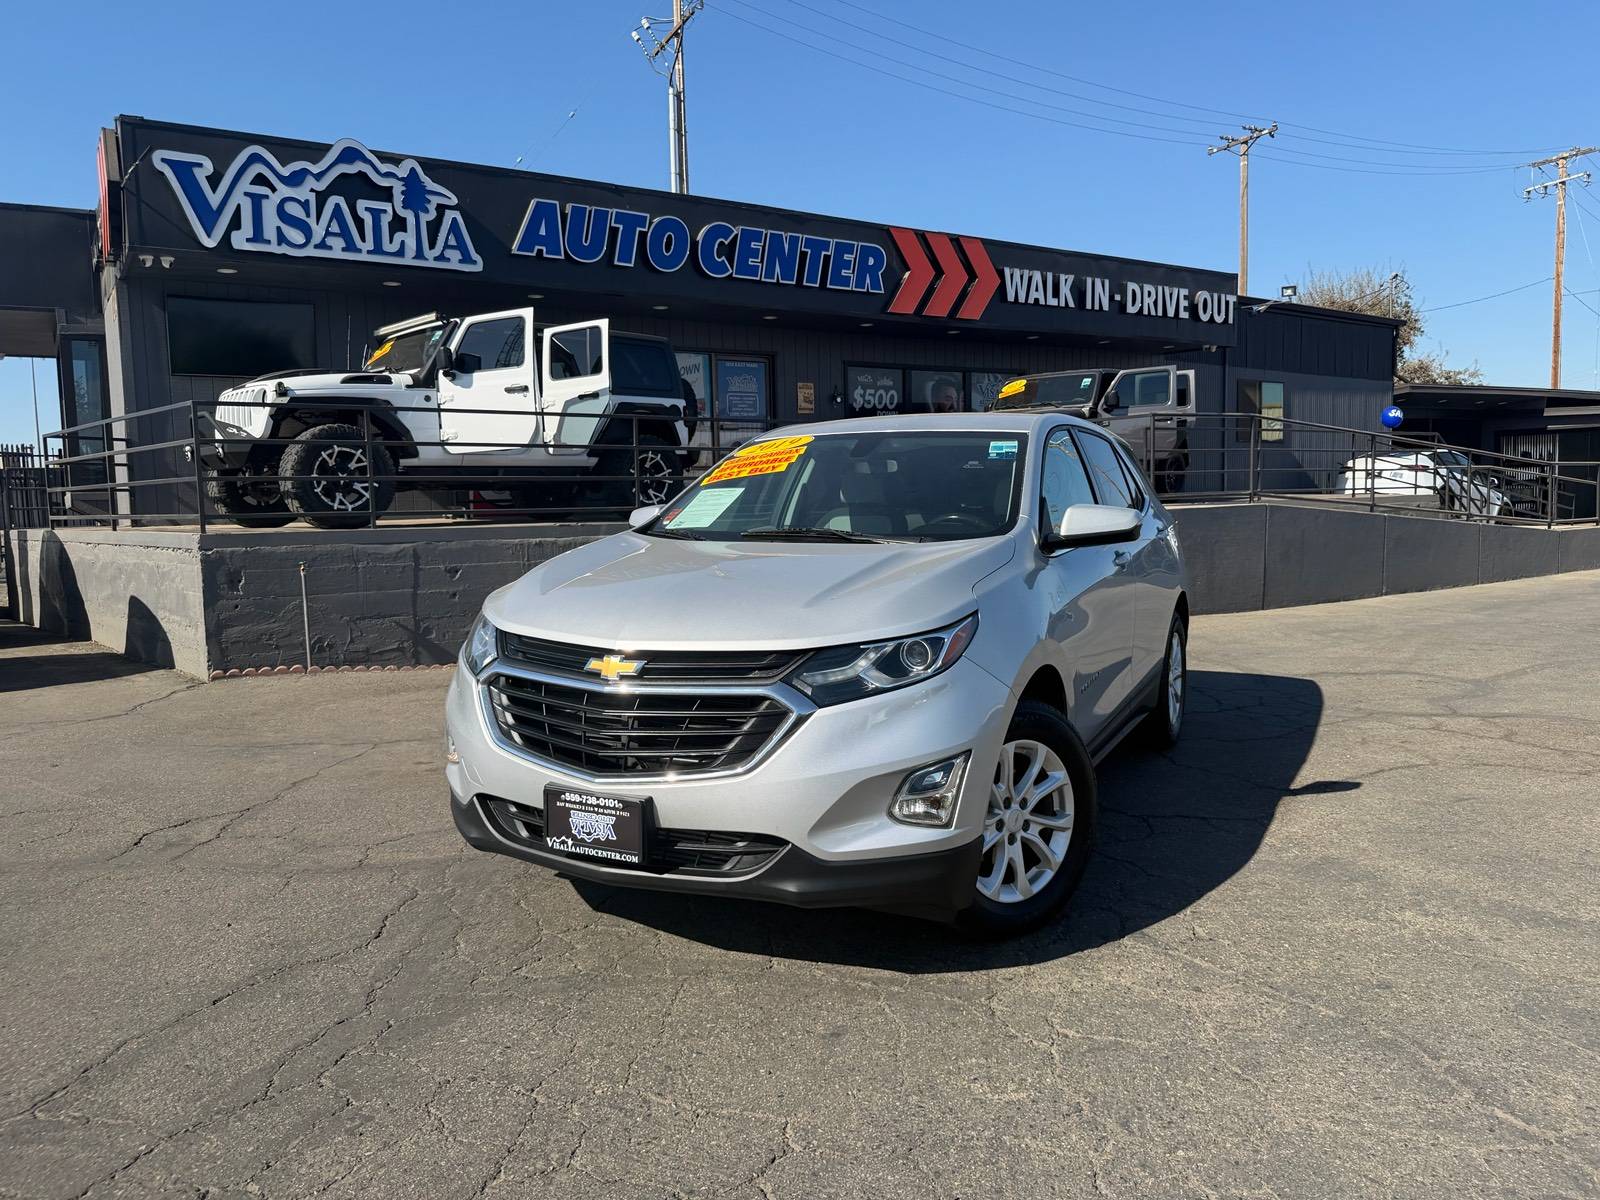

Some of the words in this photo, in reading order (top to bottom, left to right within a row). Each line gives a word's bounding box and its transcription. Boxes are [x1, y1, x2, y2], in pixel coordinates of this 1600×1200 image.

[153, 141, 483, 270] VISALIA
[512, 198, 690, 272] AUTO
[697, 222, 886, 294] CENTER
[1004, 266, 1075, 308] WALK
[1085, 276, 1110, 311] IN
[1126, 281, 1190, 320] DRIVE
[1198, 290, 1237, 325] OUT
[853, 386, 898, 411] $500
[708, 469, 744, 483] BEST
[748, 463, 783, 475] BUY
[569, 818, 617, 841] VISALIA
